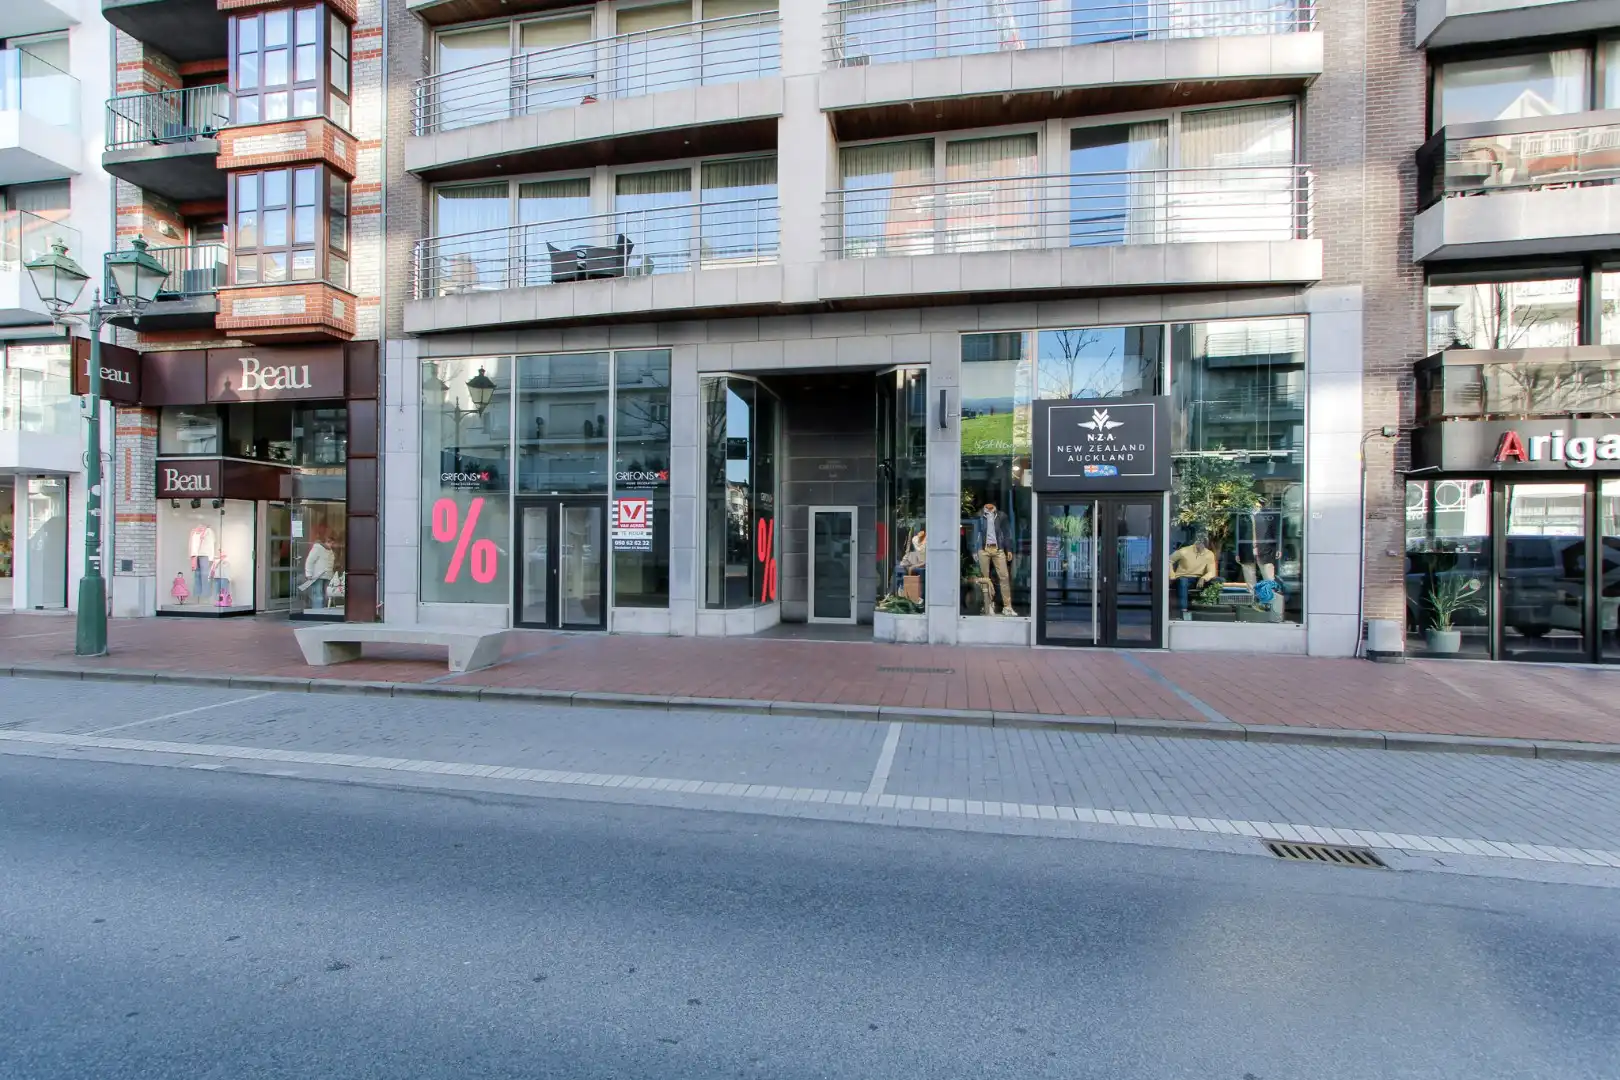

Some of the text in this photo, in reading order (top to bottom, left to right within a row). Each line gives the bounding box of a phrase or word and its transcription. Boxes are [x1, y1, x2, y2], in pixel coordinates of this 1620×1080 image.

[237, 357, 312, 391] Beau
[1089, 443, 1145, 452] ZEALAND
[1494, 429, 1620, 468] Ariga
[1067, 453, 1134, 462] AUCKLAND
[163, 468, 212, 491] Beau
[615, 471, 655, 480] GRIFONS
